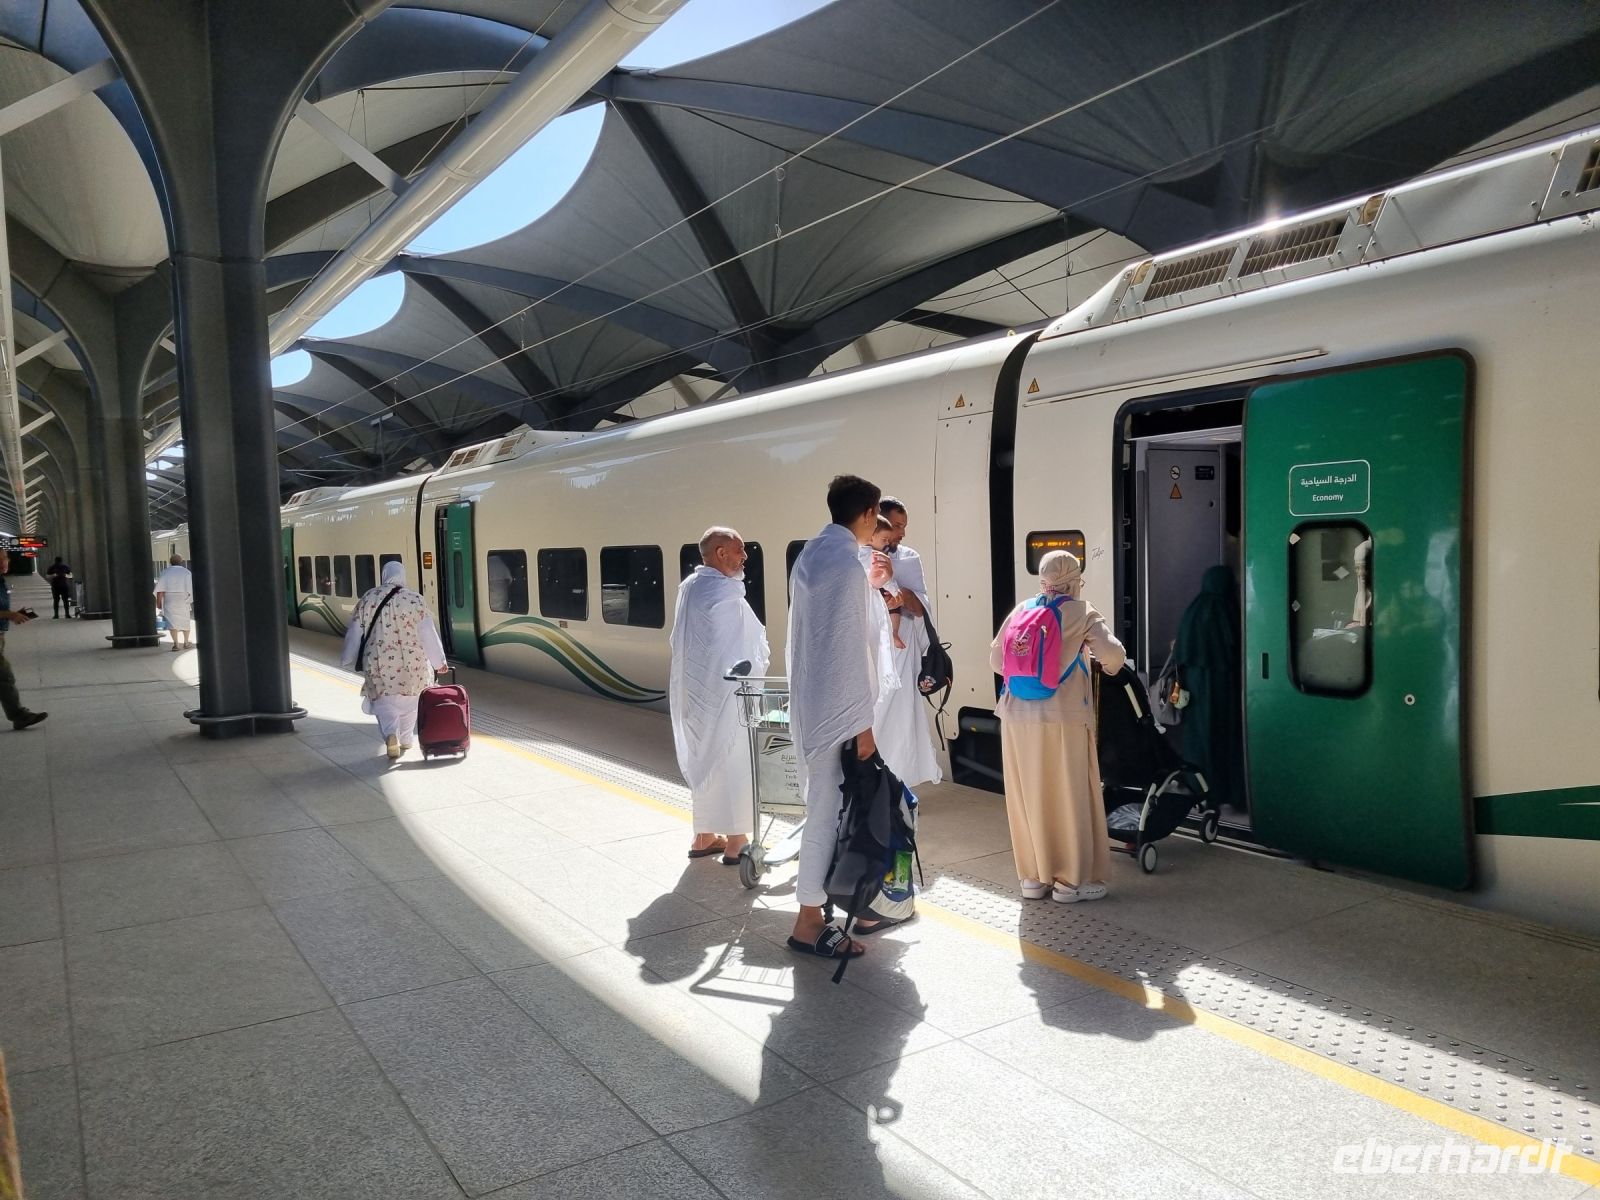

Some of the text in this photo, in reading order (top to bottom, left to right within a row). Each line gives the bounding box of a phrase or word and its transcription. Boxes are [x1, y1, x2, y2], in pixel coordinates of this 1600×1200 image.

[1300, 473, 1357, 487] الدرجة السياحية
[1312, 494, 1344, 502] Economy
